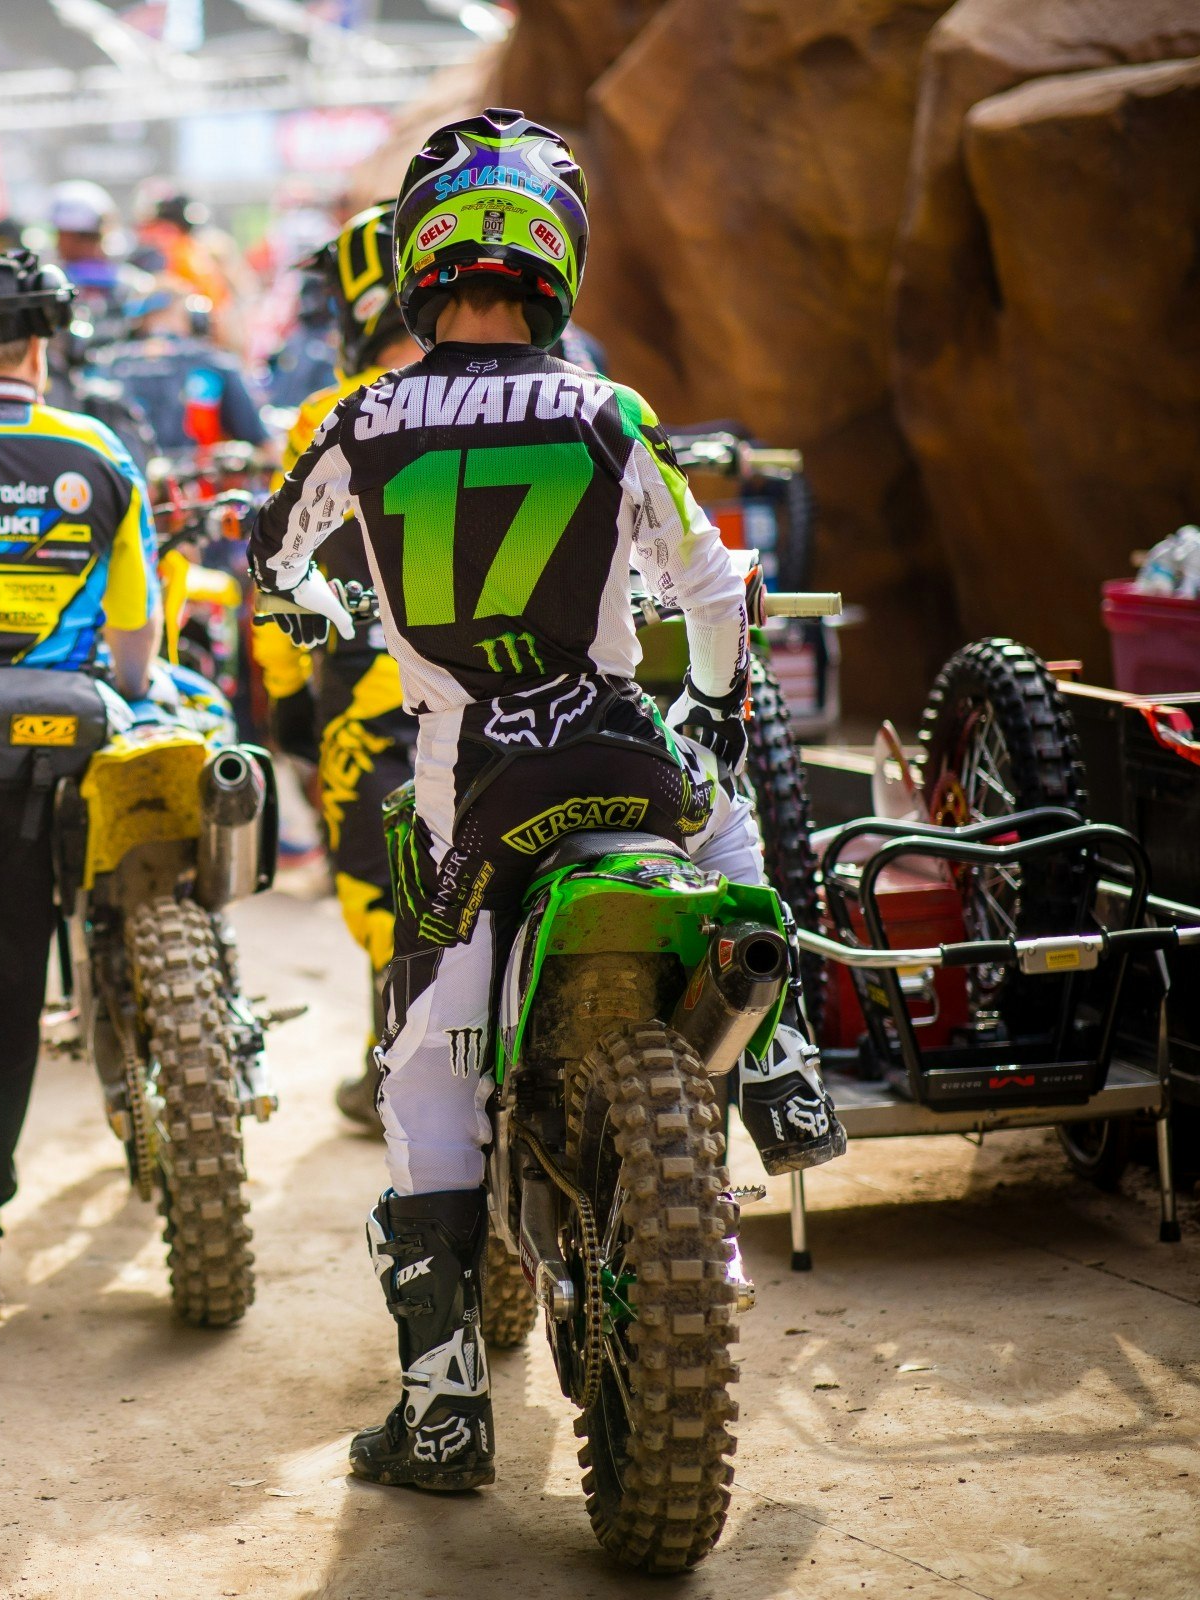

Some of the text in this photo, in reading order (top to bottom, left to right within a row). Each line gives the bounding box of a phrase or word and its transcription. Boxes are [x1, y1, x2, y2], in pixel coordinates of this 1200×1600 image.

[420, 219, 452, 247] BELL
[484, 220, 503, 231] DOT
[534, 223, 563, 257] BELL
[354, 373, 614, 441] SAVATGY
[383, 442, 594, 627] 17
[512, 801, 643, 852] VERSACE
[769, 1107, 785, 1141] FOX
[463, 1269, 472, 1278] 17
[478, 1418, 489, 1453] FOX
